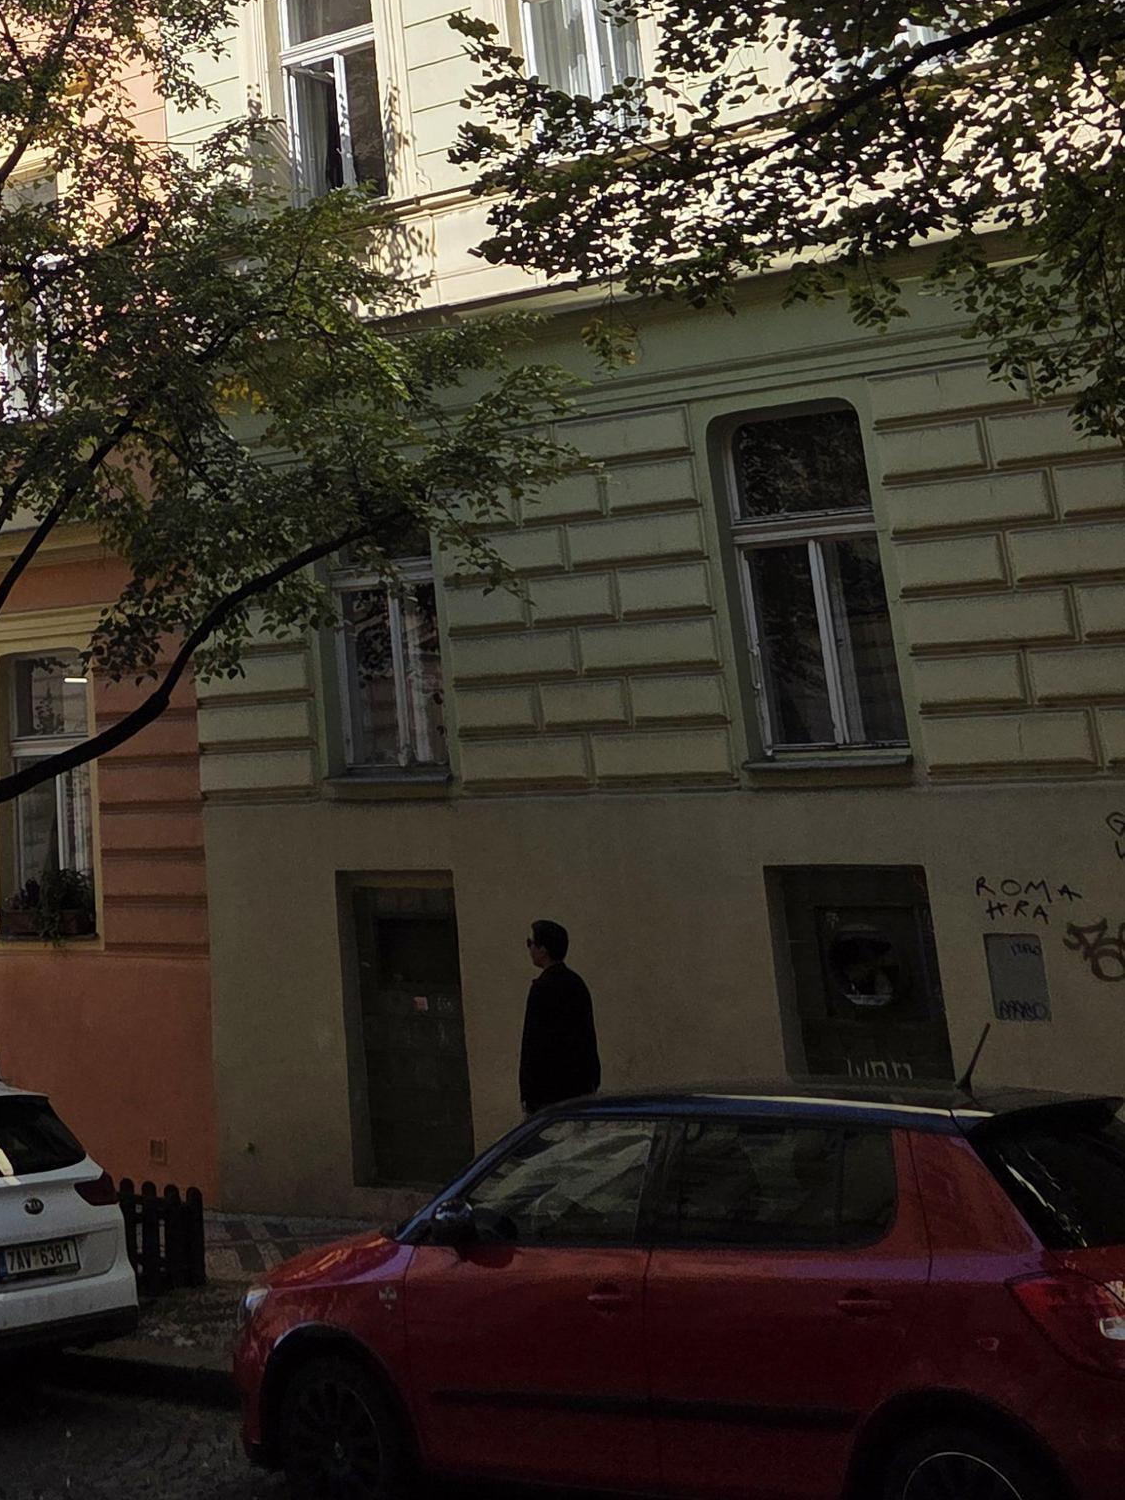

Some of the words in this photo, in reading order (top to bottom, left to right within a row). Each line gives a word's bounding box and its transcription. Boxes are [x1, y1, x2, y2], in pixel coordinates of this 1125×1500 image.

[976, 875, 1083, 904] ROMA
[7, 1248, 31, 1271] 7AV
[41, 1243, 72, 1266] 6381
